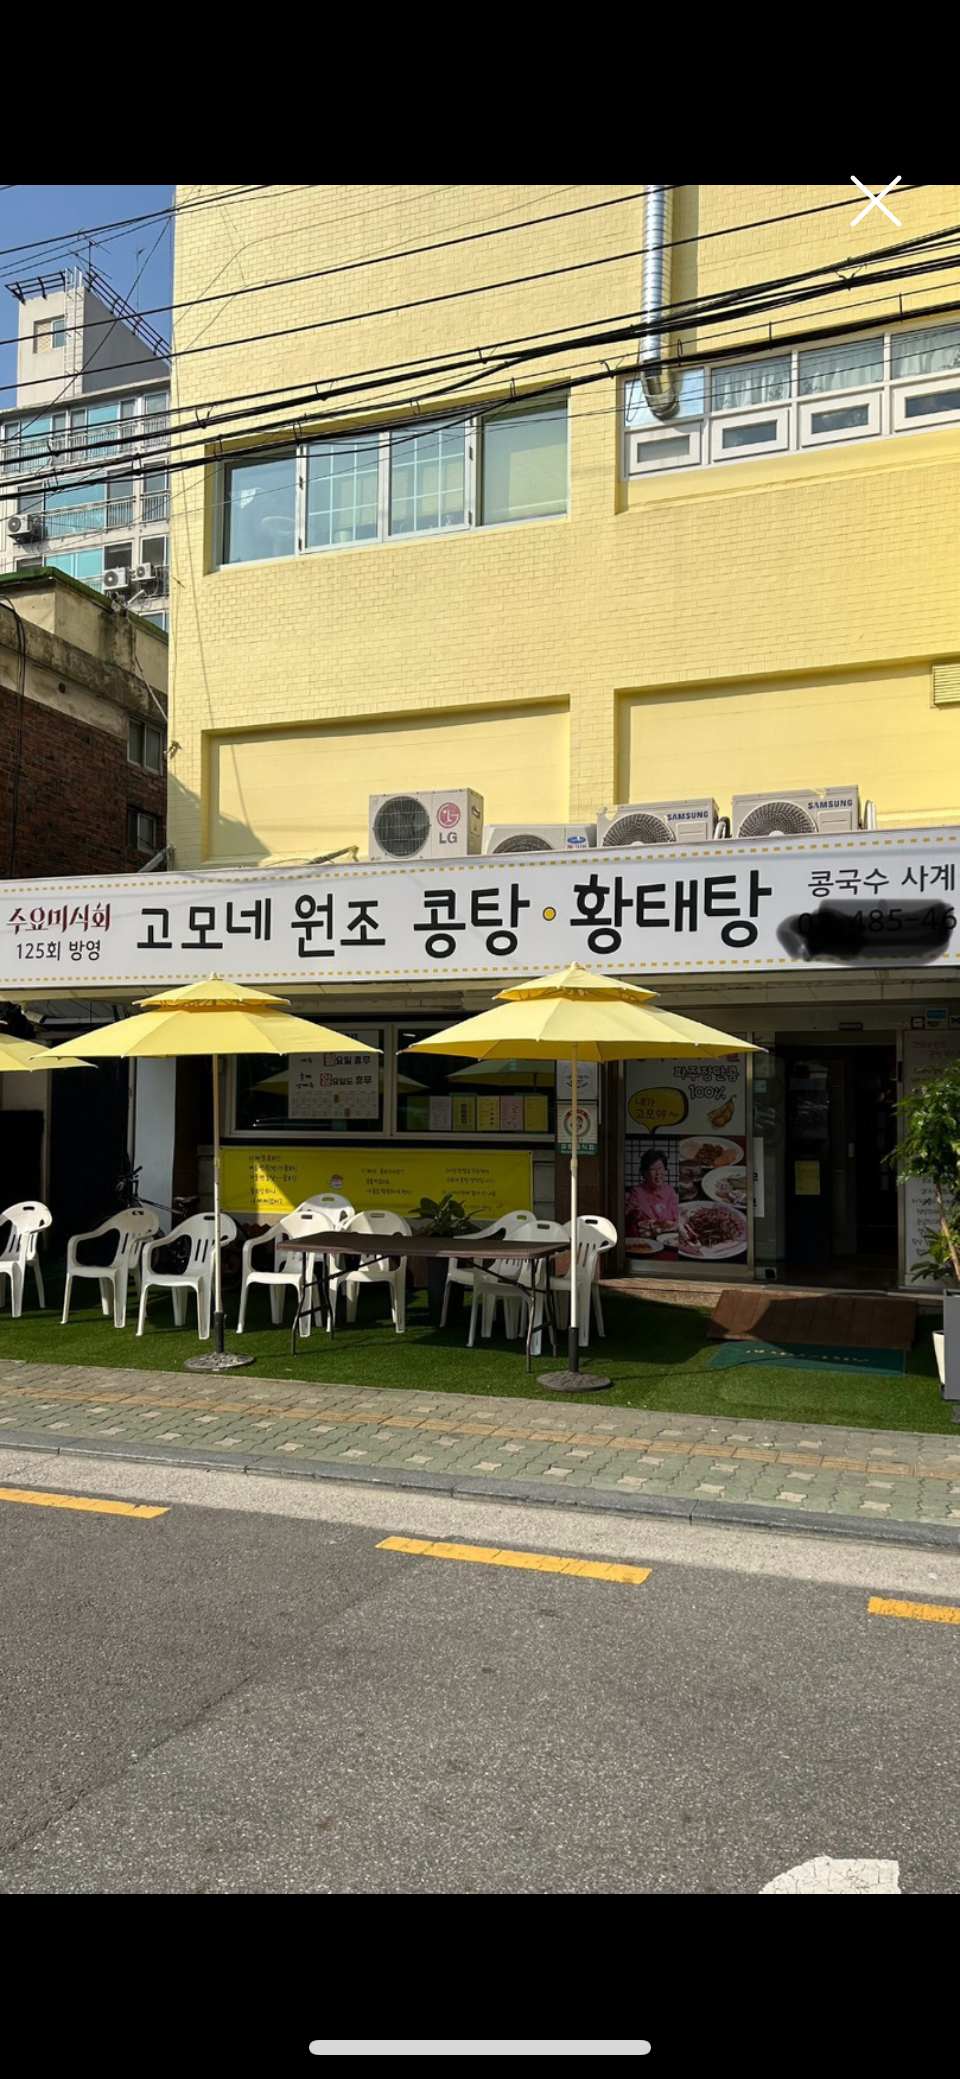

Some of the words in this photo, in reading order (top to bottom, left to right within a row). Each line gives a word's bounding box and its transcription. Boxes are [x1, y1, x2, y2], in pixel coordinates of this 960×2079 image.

[807, 799, 853, 810] SAMSUNG
[667, 811, 709, 821] SAMSUNG
[438, 832, 458, 844] LG
[808, 868, 890, 897] 콩국수
[901, 863, 956, 892] 사계
[6, 902, 111, 935] 수요미식회
[137, 898, 272, 950] 고모네
[291, 893, 386, 958] 원조
[16, 941, 61, 961] 125회
[69, 940, 101, 962] 방영
[354, 1055, 371, 1065] 휴무
[355, 1075, 372, 1085] 휴무
[688, 1084, 727, 1100] 100%
